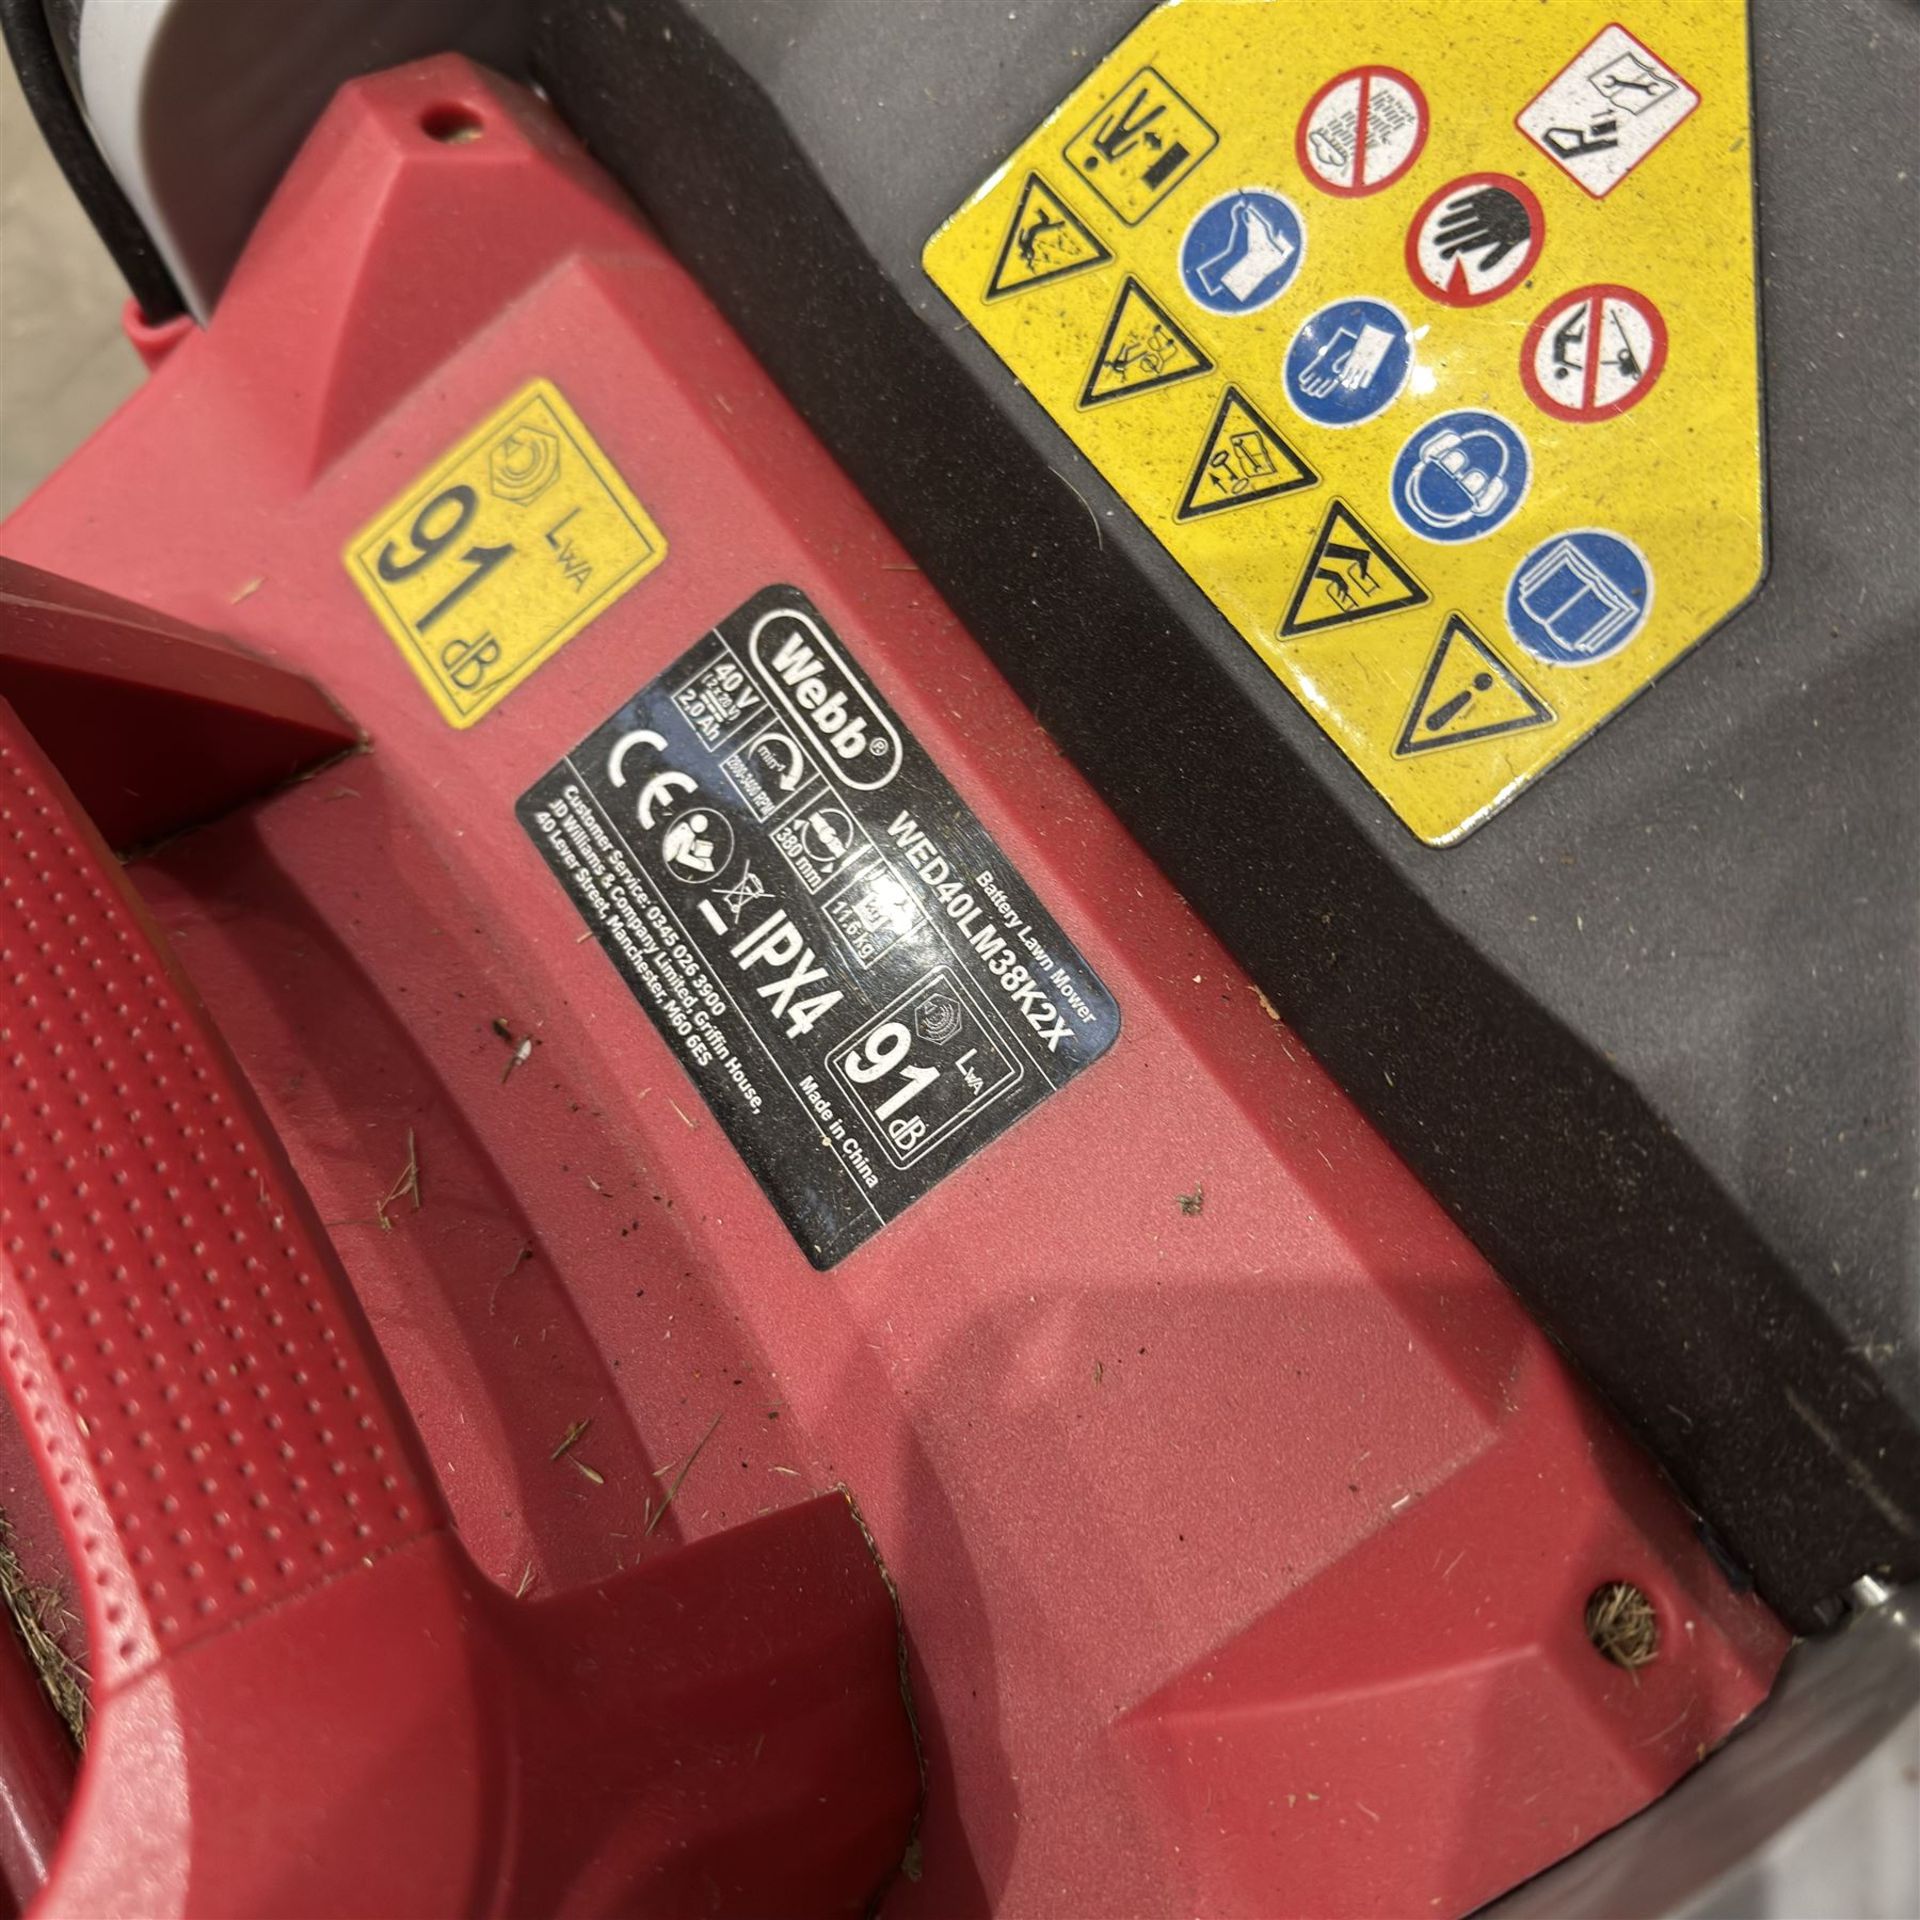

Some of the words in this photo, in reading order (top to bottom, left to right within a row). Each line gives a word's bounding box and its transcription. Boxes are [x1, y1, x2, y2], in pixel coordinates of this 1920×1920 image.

[376, 484, 517, 634] 91
[440, 630, 502, 692] dB
[714, 663, 744, 692] 40
[735, 685, 760, 709] V
[696, 715, 720, 742] Ah
[752, 791, 777, 816] RPM
[776, 827, 807, 858] 380
[795, 856, 822, 888] mm
[535, 811, 557, 833] 40
[548, 829, 581, 870] Lever
[574, 867, 611, 920] Street,
[605, 914, 668, 1004] Manchester,
[663, 999, 693, 1036] M60
[685, 1034, 713, 1066] 6ES
[563, 784, 614, 852] Customer
[607, 849, 652, 909] Service:
[646, 906, 680, 947] 0345
[672, 944, 700, 977] 026
[692, 974, 726, 1016] 3900
[832, 901, 863, 936] 11.6
[852, 931, 881, 959] kg
[886, 809, 1075, 1053] WED40LM38K2X
[975, 870, 1023, 929] Battery
[1017, 925, 1055, 972] Lawn
[1049, 967, 1097, 1023] Mower
[548, 798, 569, 818] JD
[562, 814, 606, 876] Williams
[601, 873, 616, 889] &
[609, 885, 660, 954] Company
[653, 951, 699, 1015] Limited,
[693, 1010, 730, 1060] Griffin
[724, 1056, 763, 1115] House,
[730, 908, 845, 1039] IPX4
[844, 1021, 941, 1122] 91
[798, 1074, 834, 1122] Made
[828, 1118, 846, 1140] in
[842, 1137, 879, 1189] China
[888, 1115, 927, 1151] dB
